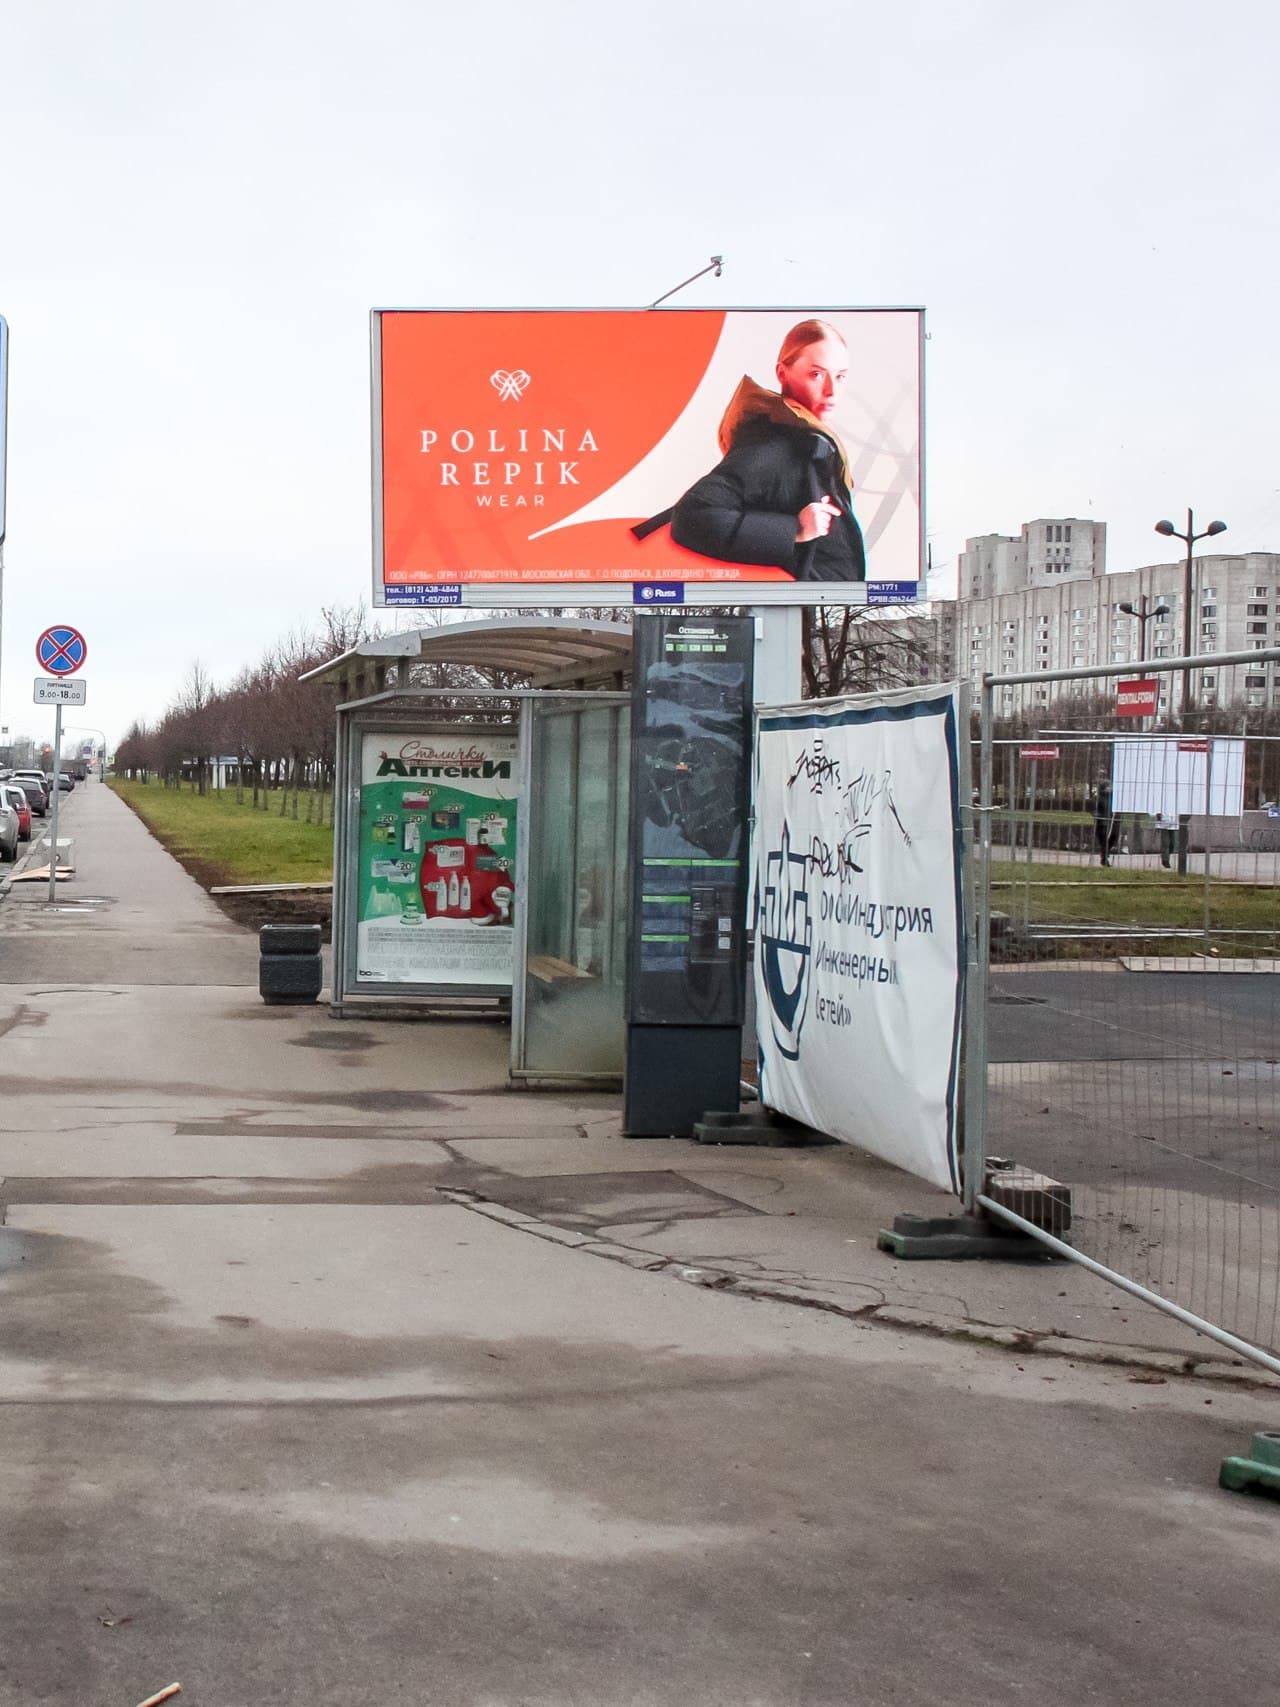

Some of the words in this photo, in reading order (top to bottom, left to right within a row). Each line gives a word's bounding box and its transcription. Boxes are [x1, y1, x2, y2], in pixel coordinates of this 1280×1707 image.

[420, 429, 599, 452] POLINA
[440, 461, 580, 485] REPIK
[476, 494, 545, 507] WEAR
[654, 588, 677, 598] Russ
